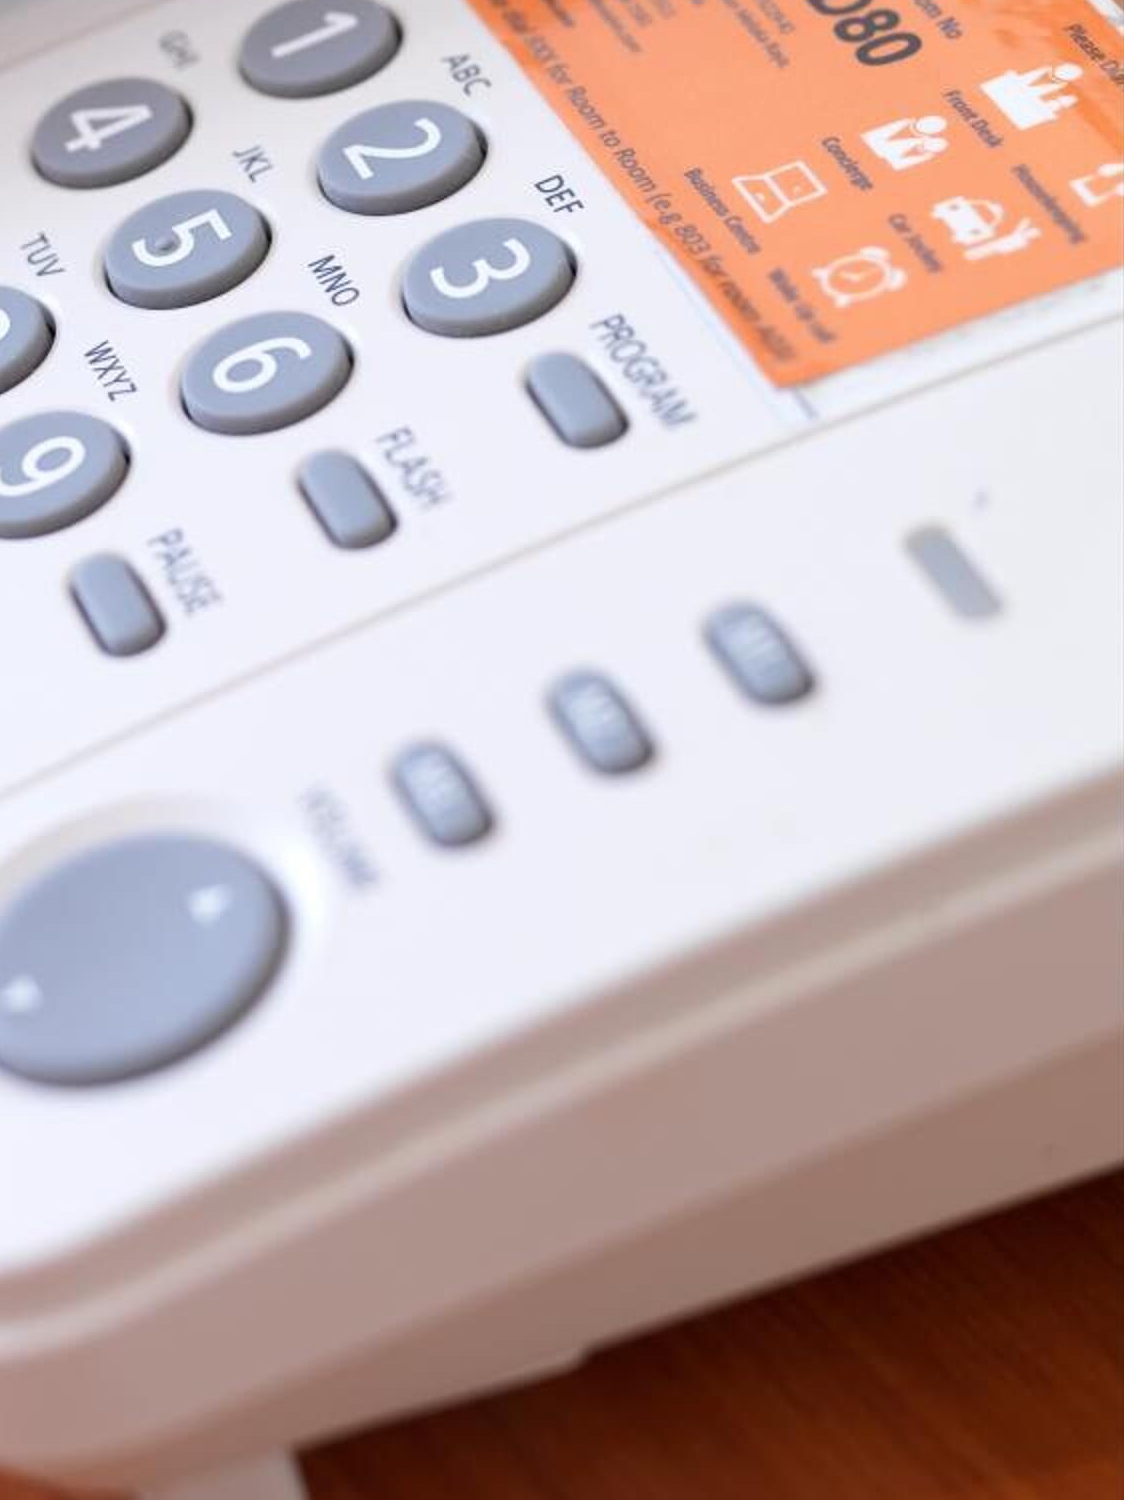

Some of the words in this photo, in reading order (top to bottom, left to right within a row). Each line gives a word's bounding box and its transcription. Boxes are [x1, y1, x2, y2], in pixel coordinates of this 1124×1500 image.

[271, 12, 357, 58] 1
[937, 15, 962, 39] No
[1066, 24, 1106, 60] Please
[442, 54, 492, 96] ABC
[65, 102, 151, 152] 4
[944, 91, 979, 122] Front
[973, 120, 1004, 148] Desk
[232, 146, 273, 183] JKL
[342, 118, 441, 179] 2
[567, 86, 606, 130] Room
[615, 148, 657, 192] Room
[679, 225, 711, 255] 803
[822, 137, 873, 191] Concierge
[535, 174, 585, 215] DEF
[684, 168, 729, 217] Business
[724, 216, 761, 254] Centre
[20, 231, 68, 278] TUV
[132, 209, 230, 267] 5
[308, 255, 359, 306] MNO
[431, 238, 529, 299] 3
[84, 340, 139, 402] WXYZ
[212, 337, 311, 393] 6
[590, 313, 697, 429] PROGRAM
[377, 426, 452, 512] FLASH
[148, 527, 224, 617] PAUSE
